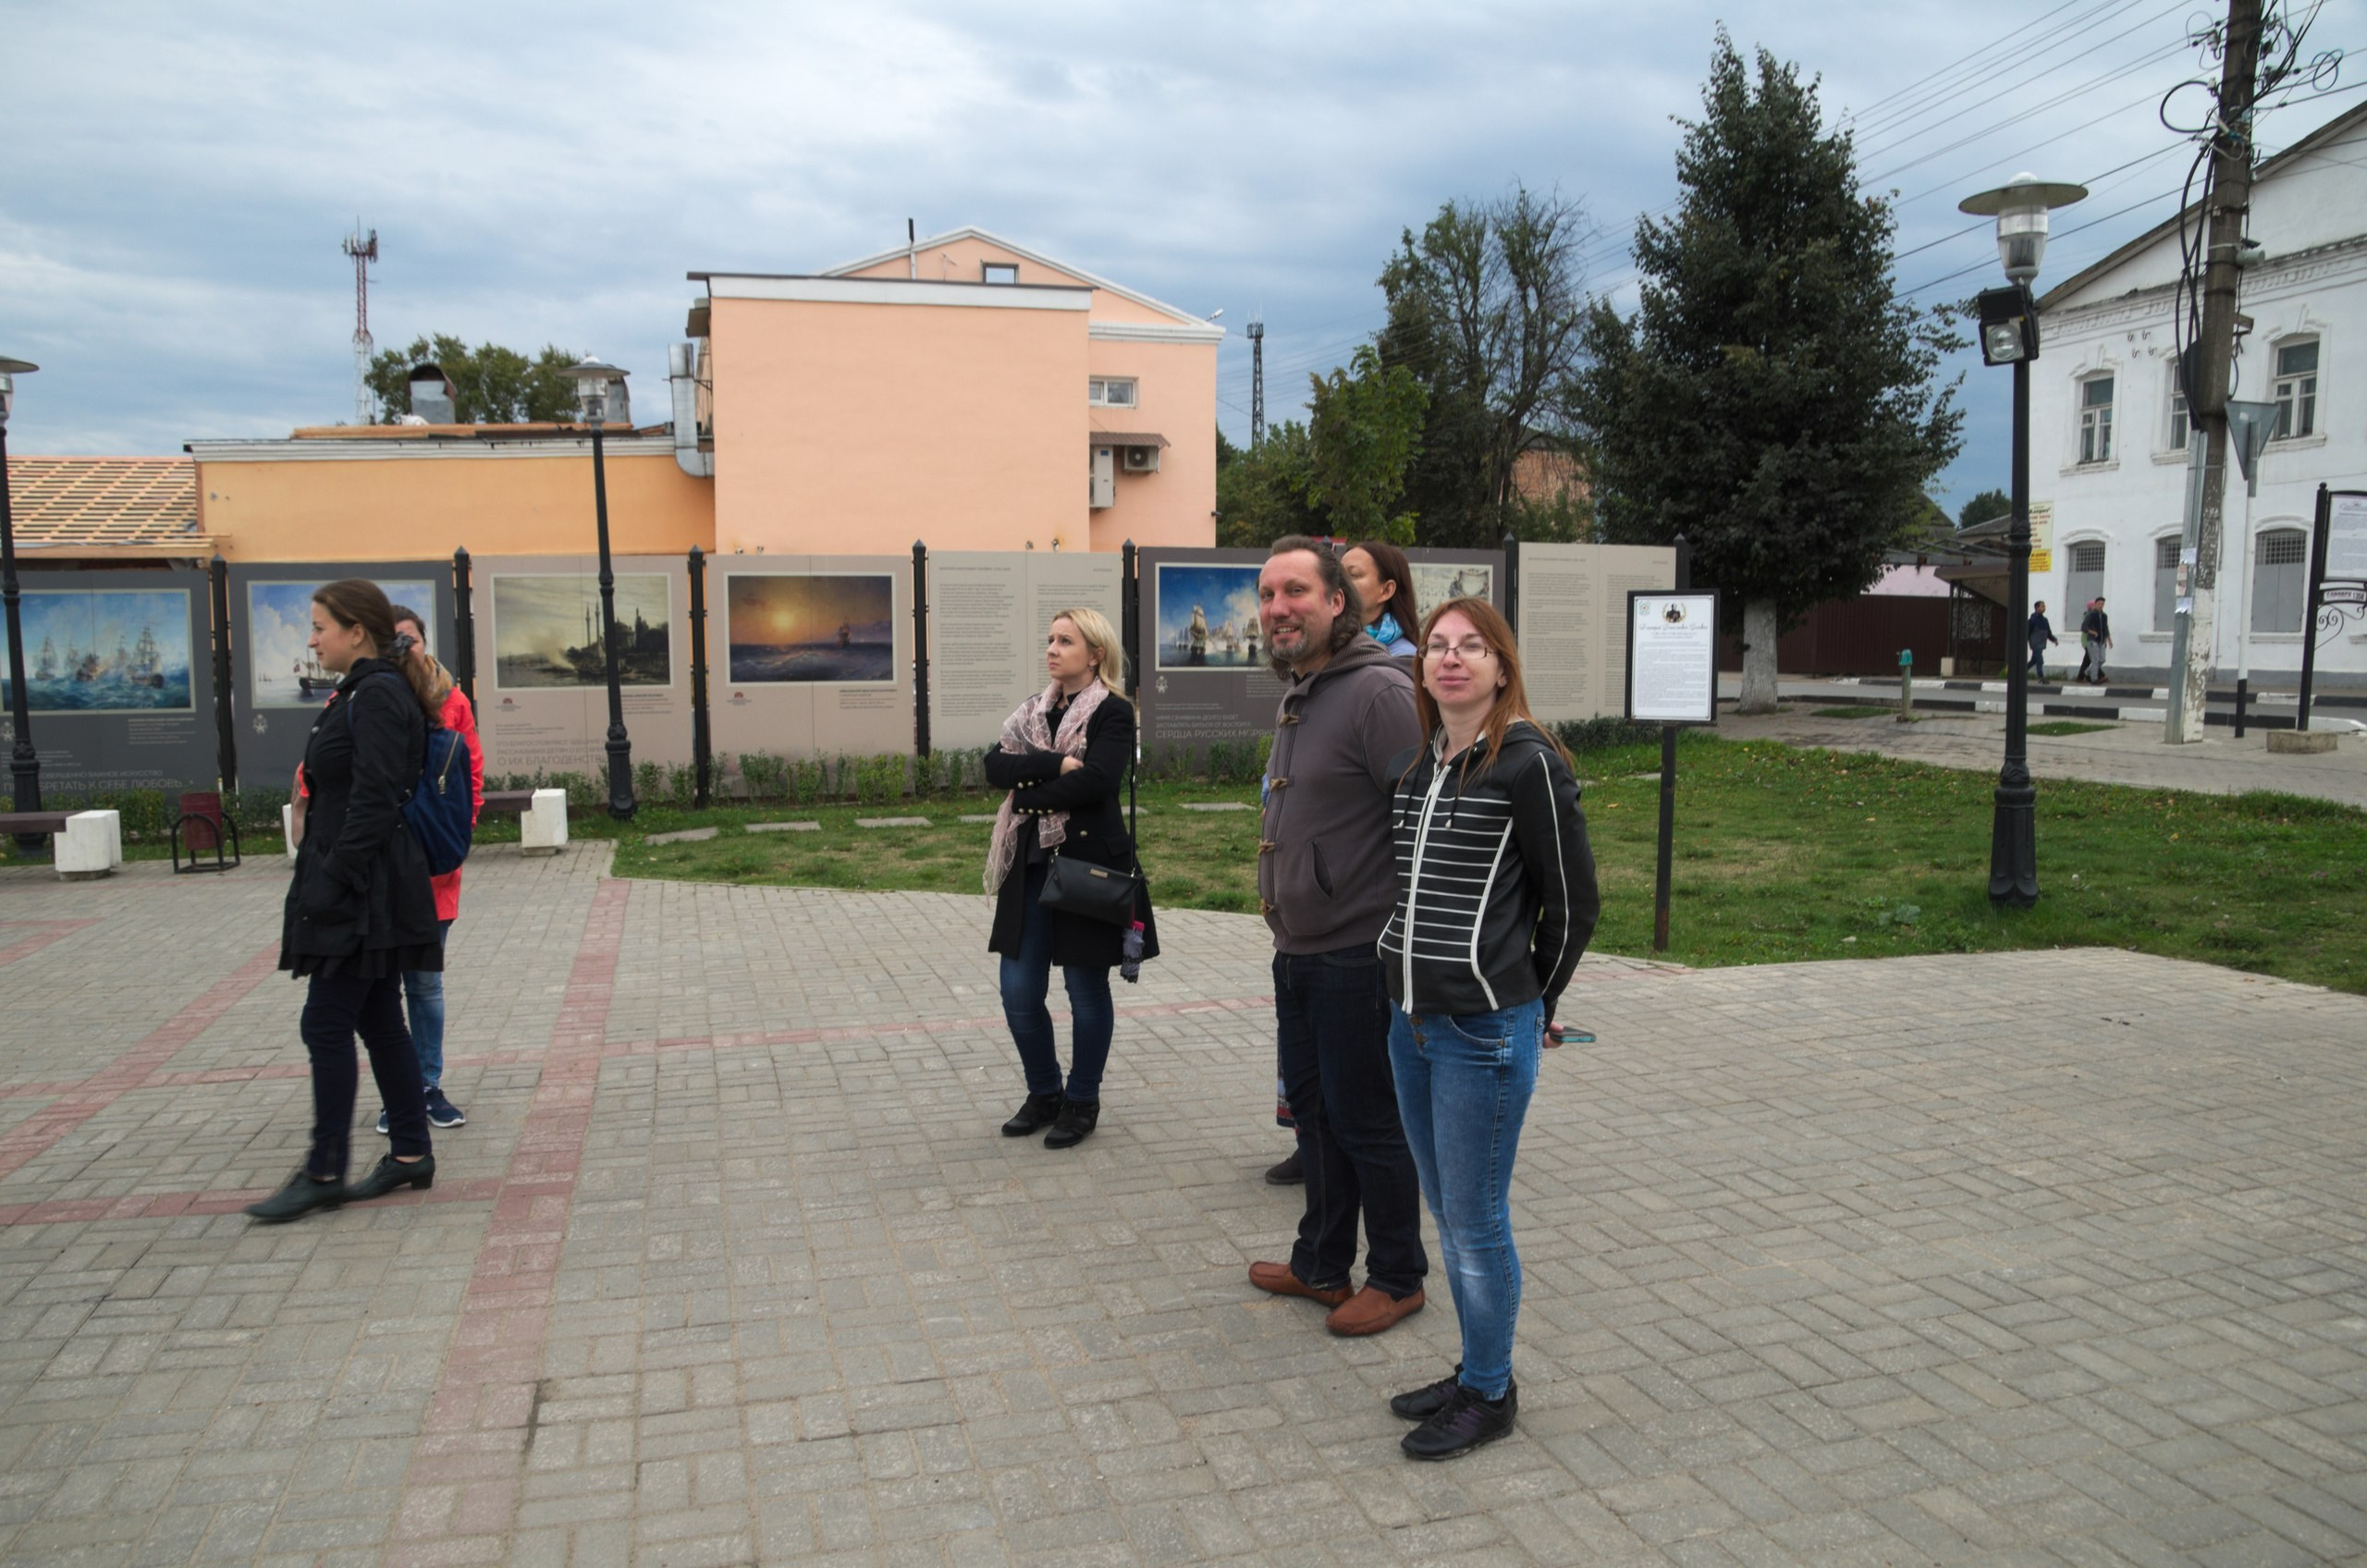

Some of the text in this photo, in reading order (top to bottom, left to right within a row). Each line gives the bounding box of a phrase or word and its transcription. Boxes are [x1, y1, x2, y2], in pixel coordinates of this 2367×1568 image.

[1156, 729, 1277, 740] СЕРДЦА РУССКИХ МОРЯКО
[497, 756, 507, 766] О
[509, 756, 523, 766] ИХ
